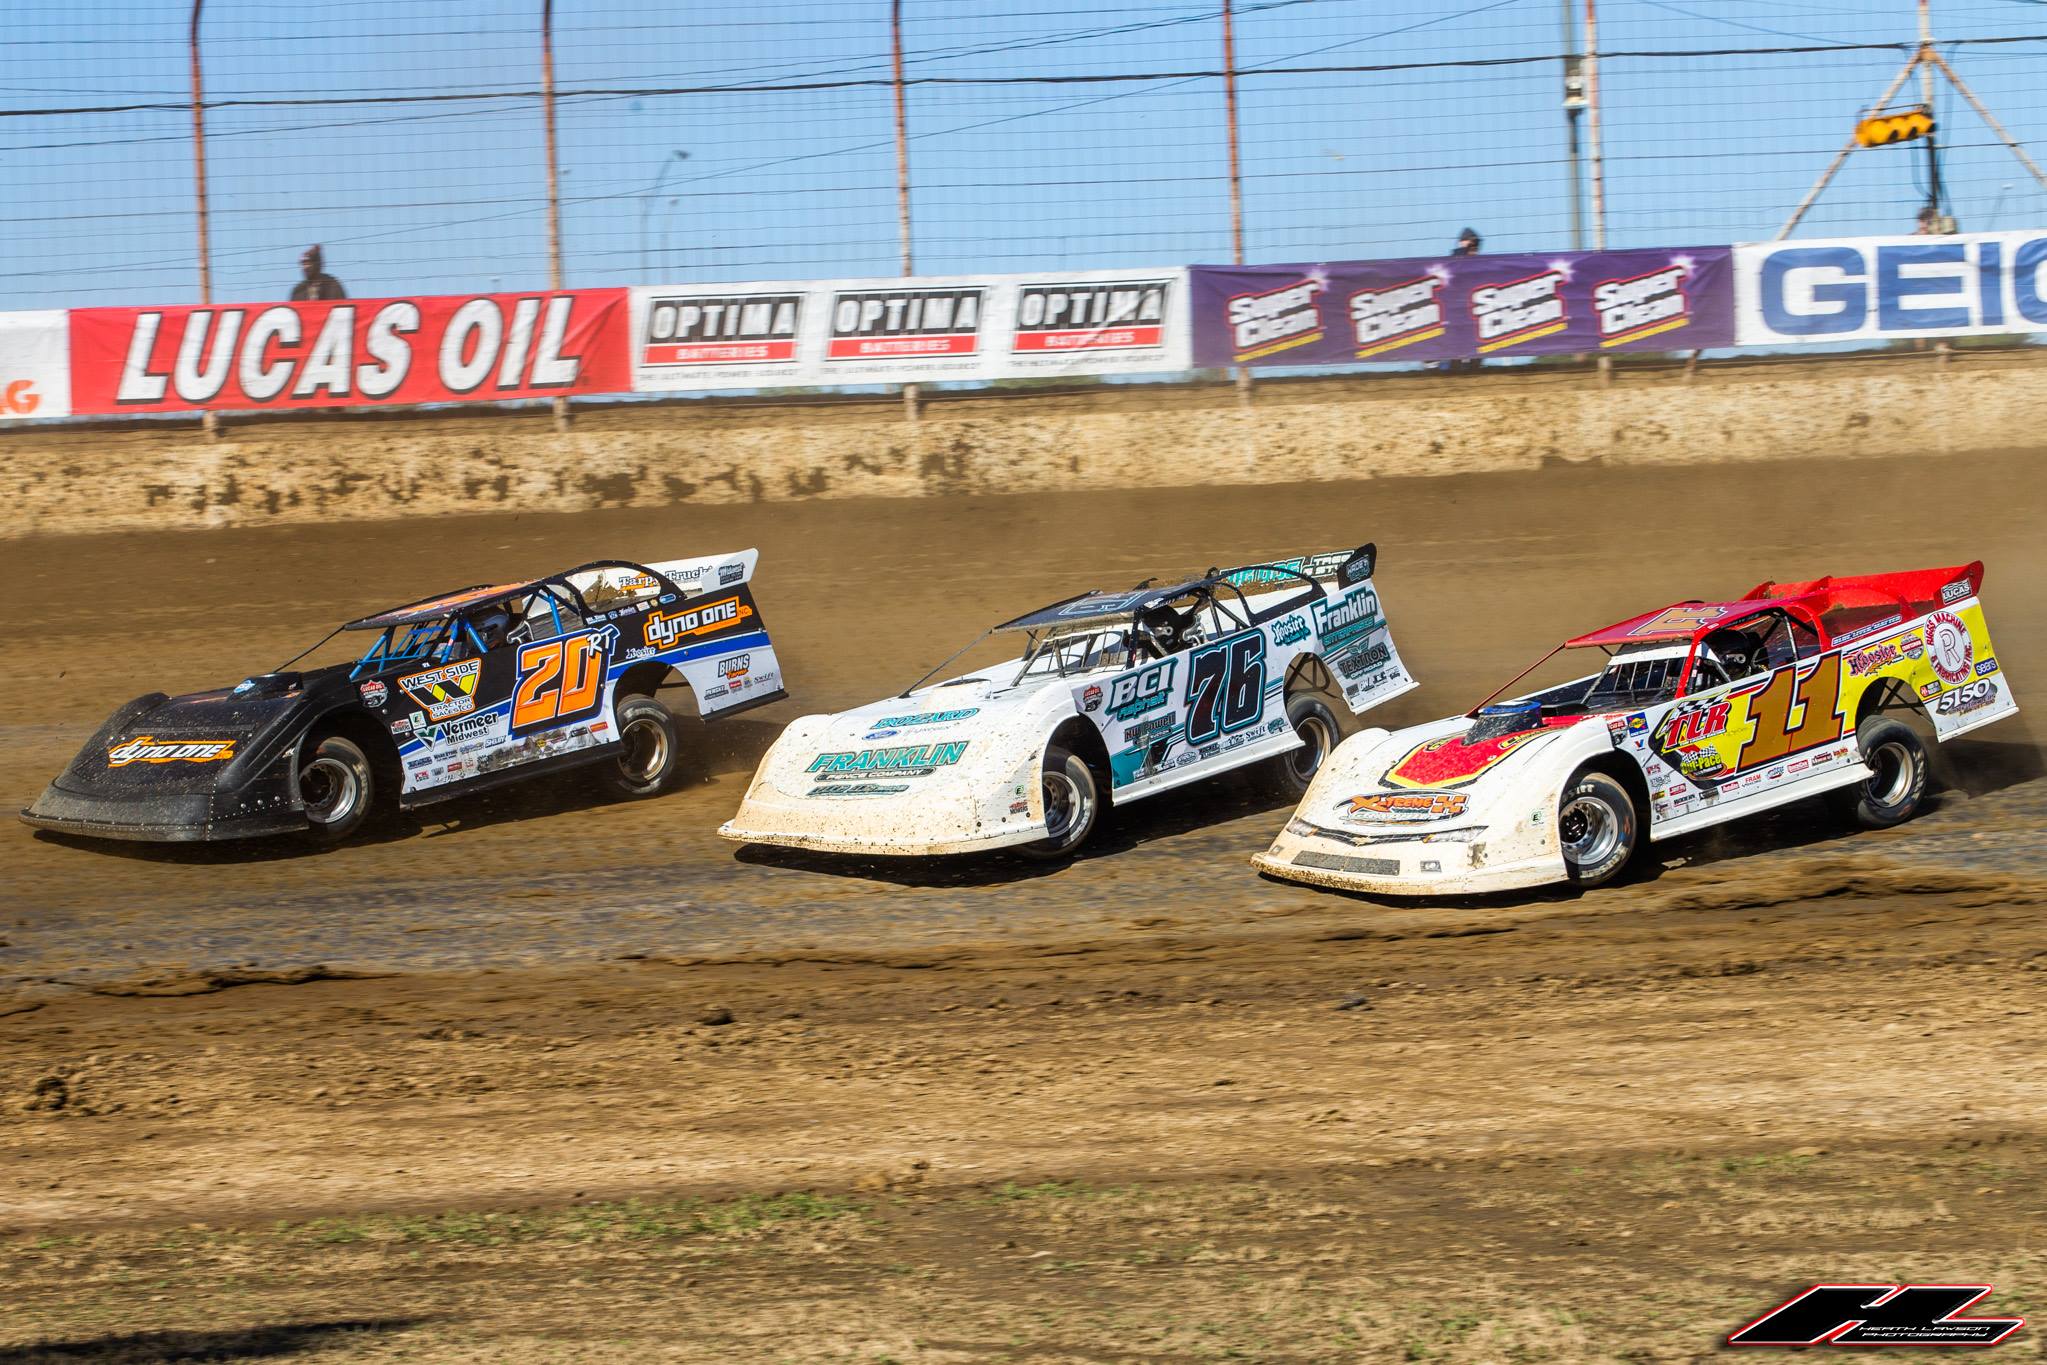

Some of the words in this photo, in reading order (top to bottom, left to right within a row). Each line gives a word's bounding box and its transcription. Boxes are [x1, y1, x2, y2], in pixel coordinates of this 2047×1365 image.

[1228, 282, 1320, 324] Super
[1350, 277, 1441, 320] Super
[1471, 273, 1563, 316] Super
[1593, 268, 1686, 311] Super
[652, 302, 796, 339] OPTIMA
[835, 296, 978, 333] OPTIMA
[1020, 289, 1161, 326] OPTIMA
[1356, 303, 1440, 344] Clean
[1479, 298, 1564, 339] Clean
[1600, 293, 1685, 334] Clean
[1045, 331, 1136, 347] BATTERIES
[1236, 308, 1319, 348] Clean
[117, 302, 420, 405] LUCAS
[439, 296, 581, 394] OIL
[676, 346, 769, 359] BATTERIES
[859, 340, 951, 354] BATTERIES
[1943, 583, 1970, 599] LUCAS
[1312, 590, 1377, 636] Franklin
[1926, 619, 1936, 646] RIGGS
[1934, 612, 1966, 635] MACHINE
[587, 629, 611, 658] RT
[1339, 642, 1391, 676] TEXTRON
[401, 670, 441, 690] WEST
[445, 661, 480, 678] SIDE
[512, 634, 602, 728] 20
[718, 654, 751, 678] BURNS
[1975, 660, 1997, 673] sears
[1107, 658, 1176, 712] BCI
[1187, 630, 1265, 743] 76
[1938, 678, 1994, 712] 5150
[431, 697, 471, 712] TRACTOR
[432, 707, 457, 719] SALES
[869, 708, 979, 729] BOZARD
[1737, 652, 1848, 772] 11
[440, 711, 499, 736] Vermeer
[446, 727, 489, 745] Midwest
[1245, 725, 1266, 738] Swift
[1665, 701, 1731, 749] TLR
[805, 741, 970, 773] FRANKLIN
[867, 769, 923, 778] COMPANY
[1745, 774, 1761, 784] FRAM
